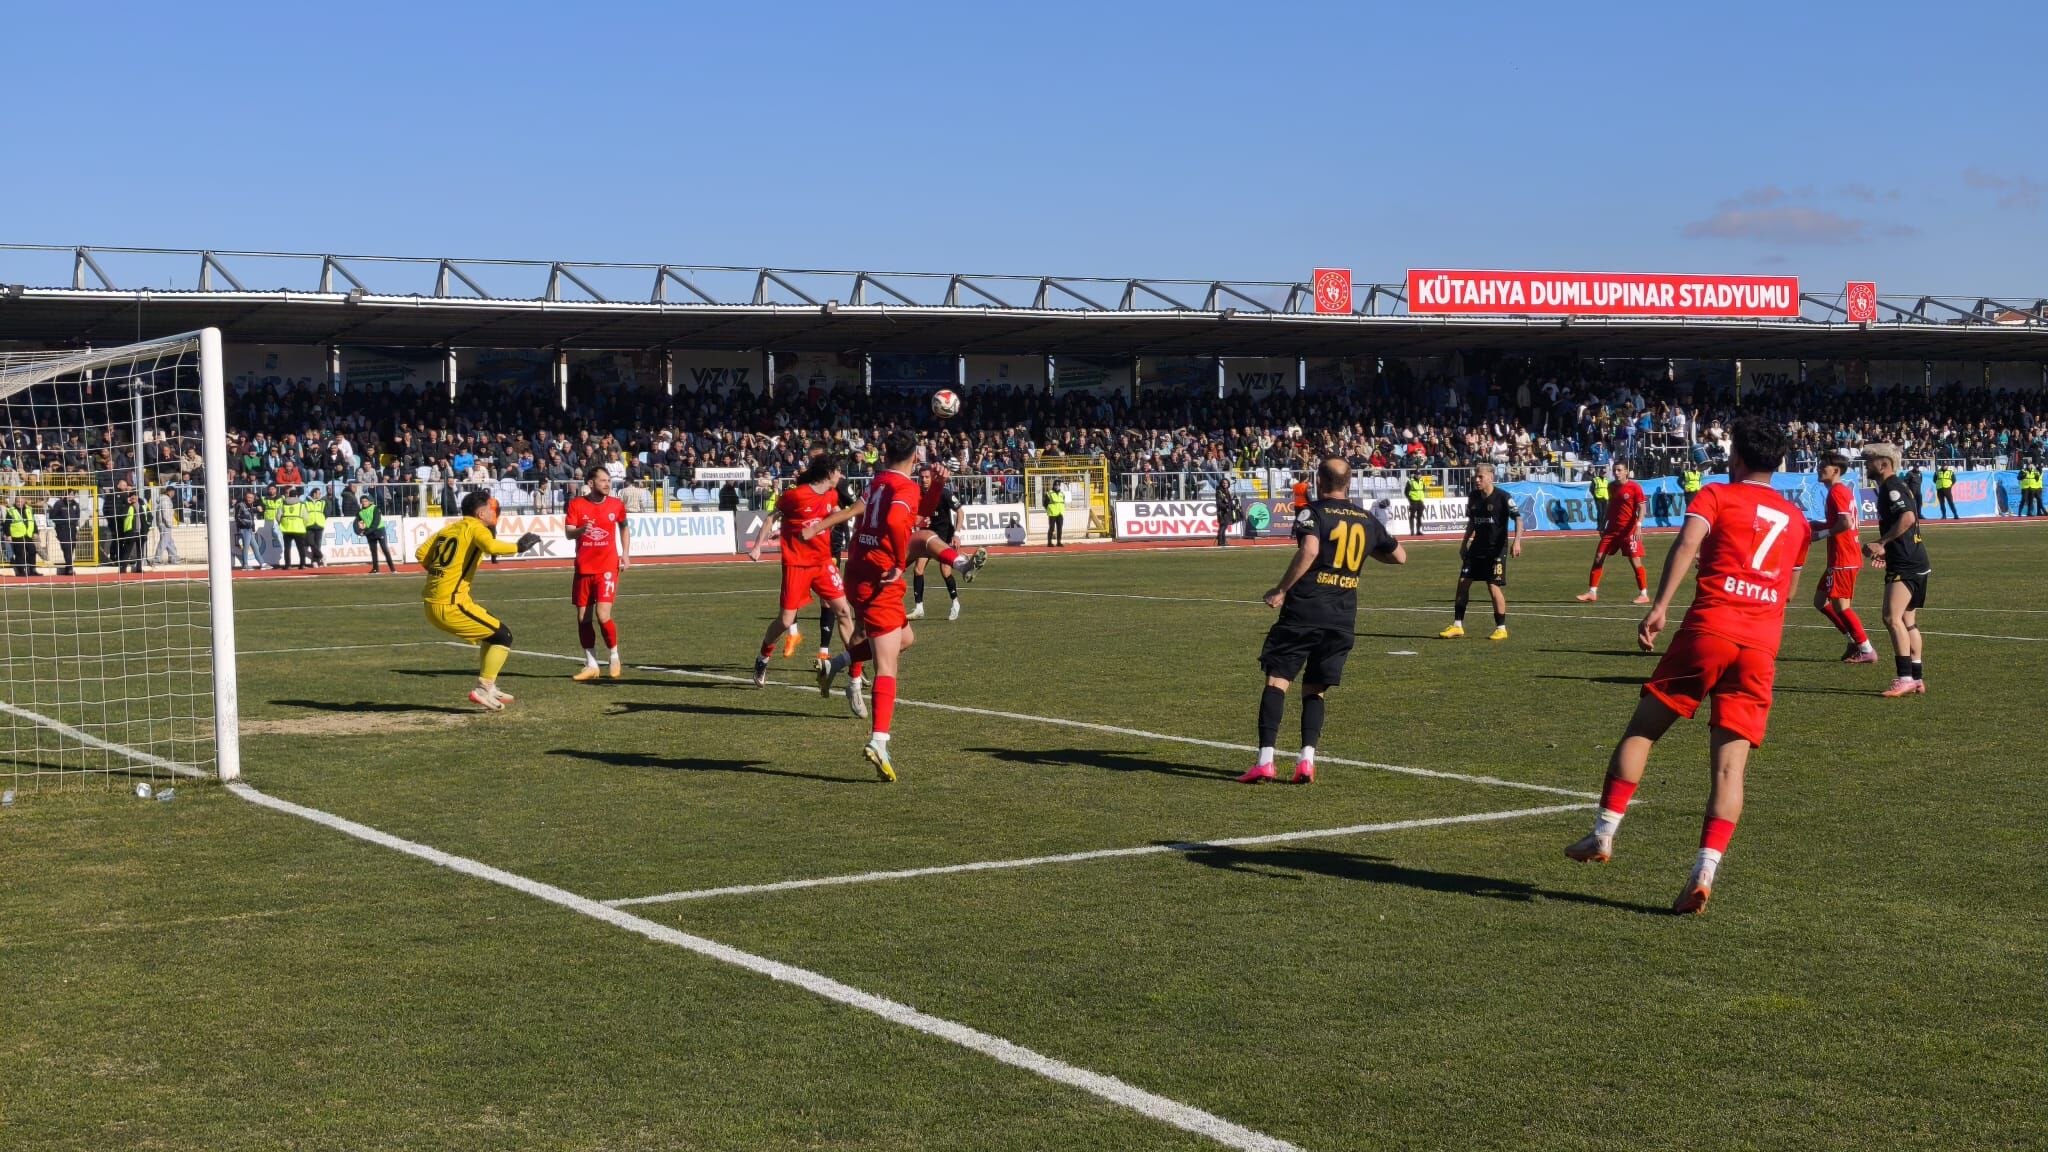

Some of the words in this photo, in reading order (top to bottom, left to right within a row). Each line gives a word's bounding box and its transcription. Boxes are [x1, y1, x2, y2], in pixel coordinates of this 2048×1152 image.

[1418, 275, 1525, 305] KÜTAHYA
[1530, 280, 1675, 308] DUMLUPINAR
[1679, 285, 1791, 309] STADYUMU
[1134, 503, 1218, 518] BANYO
[628, 515, 726, 538] BAYDEMİR
[1126, 519, 1233, 535] DÜNYASI
[1752, 504, 1790, 571] 7
[1329, 519, 1366, 573] 10
[604, 580, 616, 593] 71
